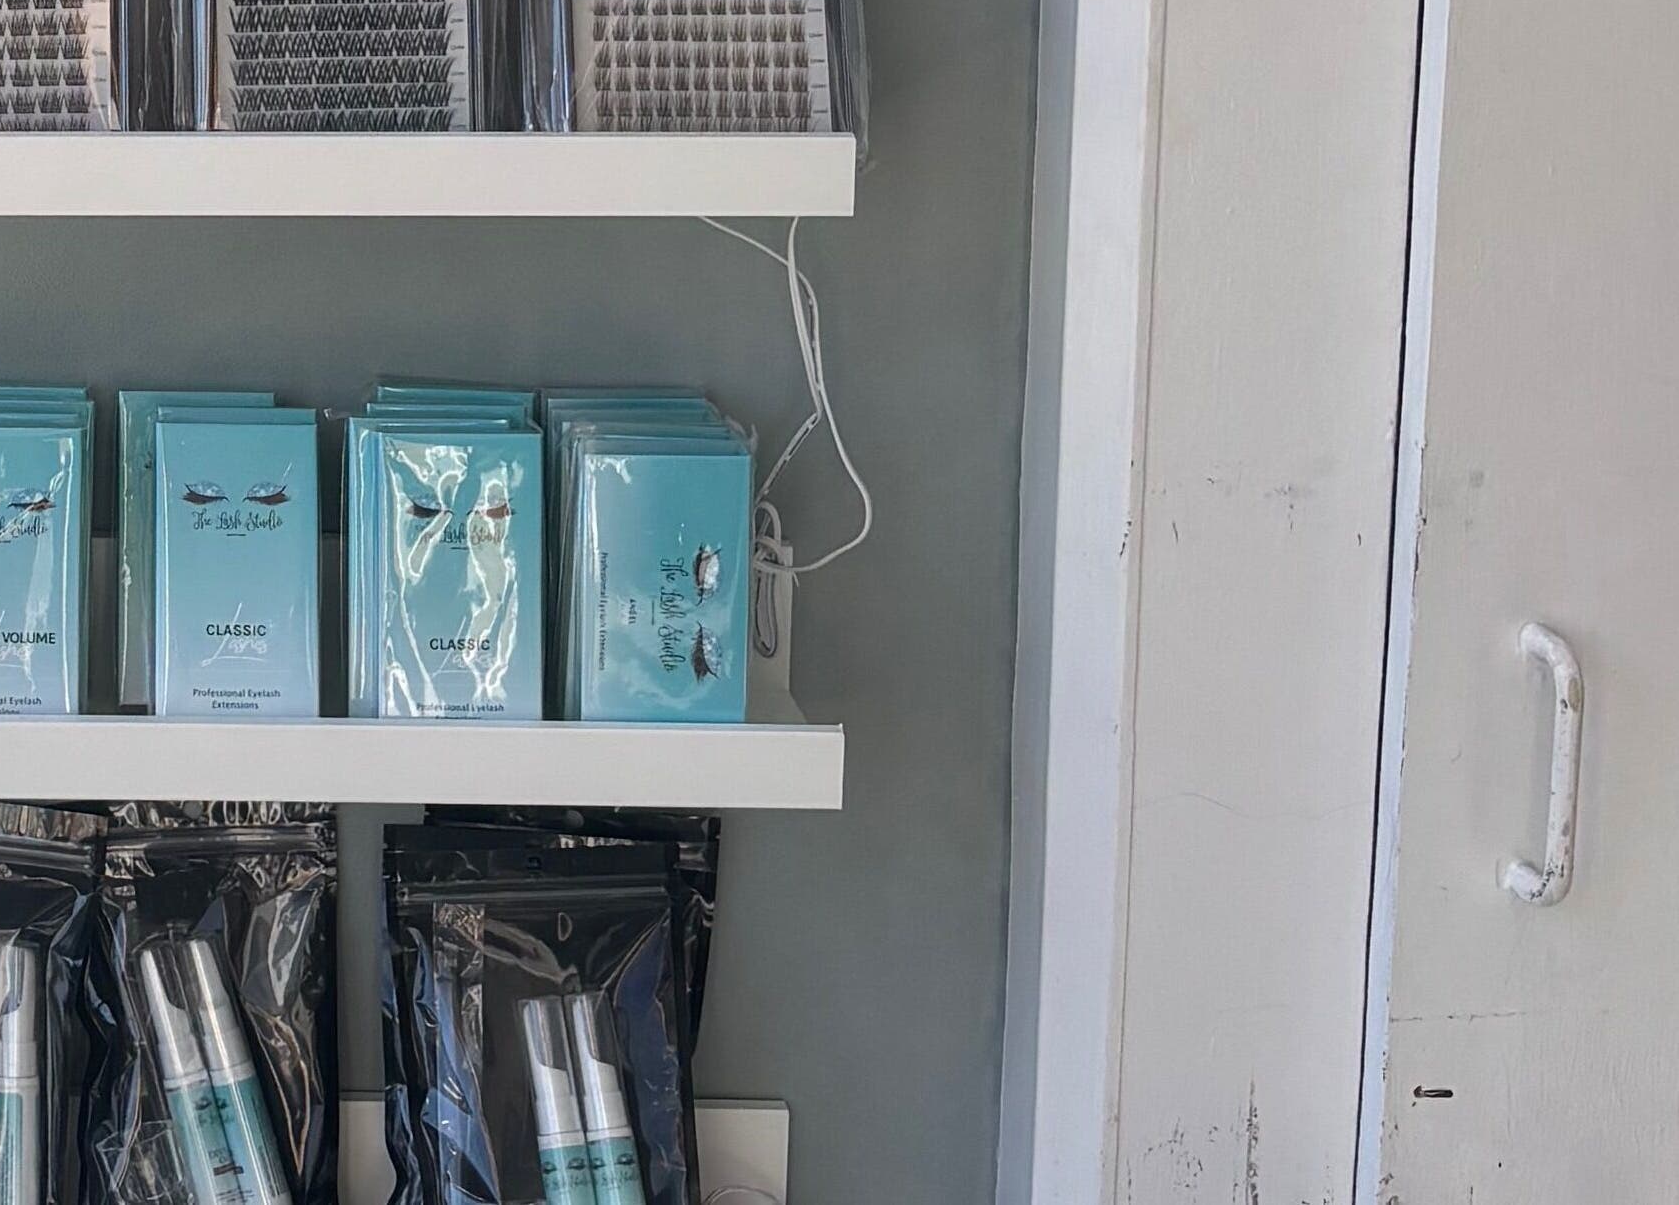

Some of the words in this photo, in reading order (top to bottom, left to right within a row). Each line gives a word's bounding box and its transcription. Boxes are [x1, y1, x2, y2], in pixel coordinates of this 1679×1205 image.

[192, 507, 214, 531] The
[215, 509, 242, 531] Lash
[244, 508, 284, 532] Studio
[660, 557, 688, 583] The
[660, 586, 687, 620] Lash
[206, 624, 267, 637] CLASSIC
[2, 632, 56, 644] VOLUME
[429, 638, 491, 651] CLASSIC
[658, 623, 686, 673] Studio
[192, 688, 246, 698] Professional
[247, 688, 281, 698] Eyelash
[9, 697, 42, 707] Eyelash
[212, 699, 259, 710] Extensions
